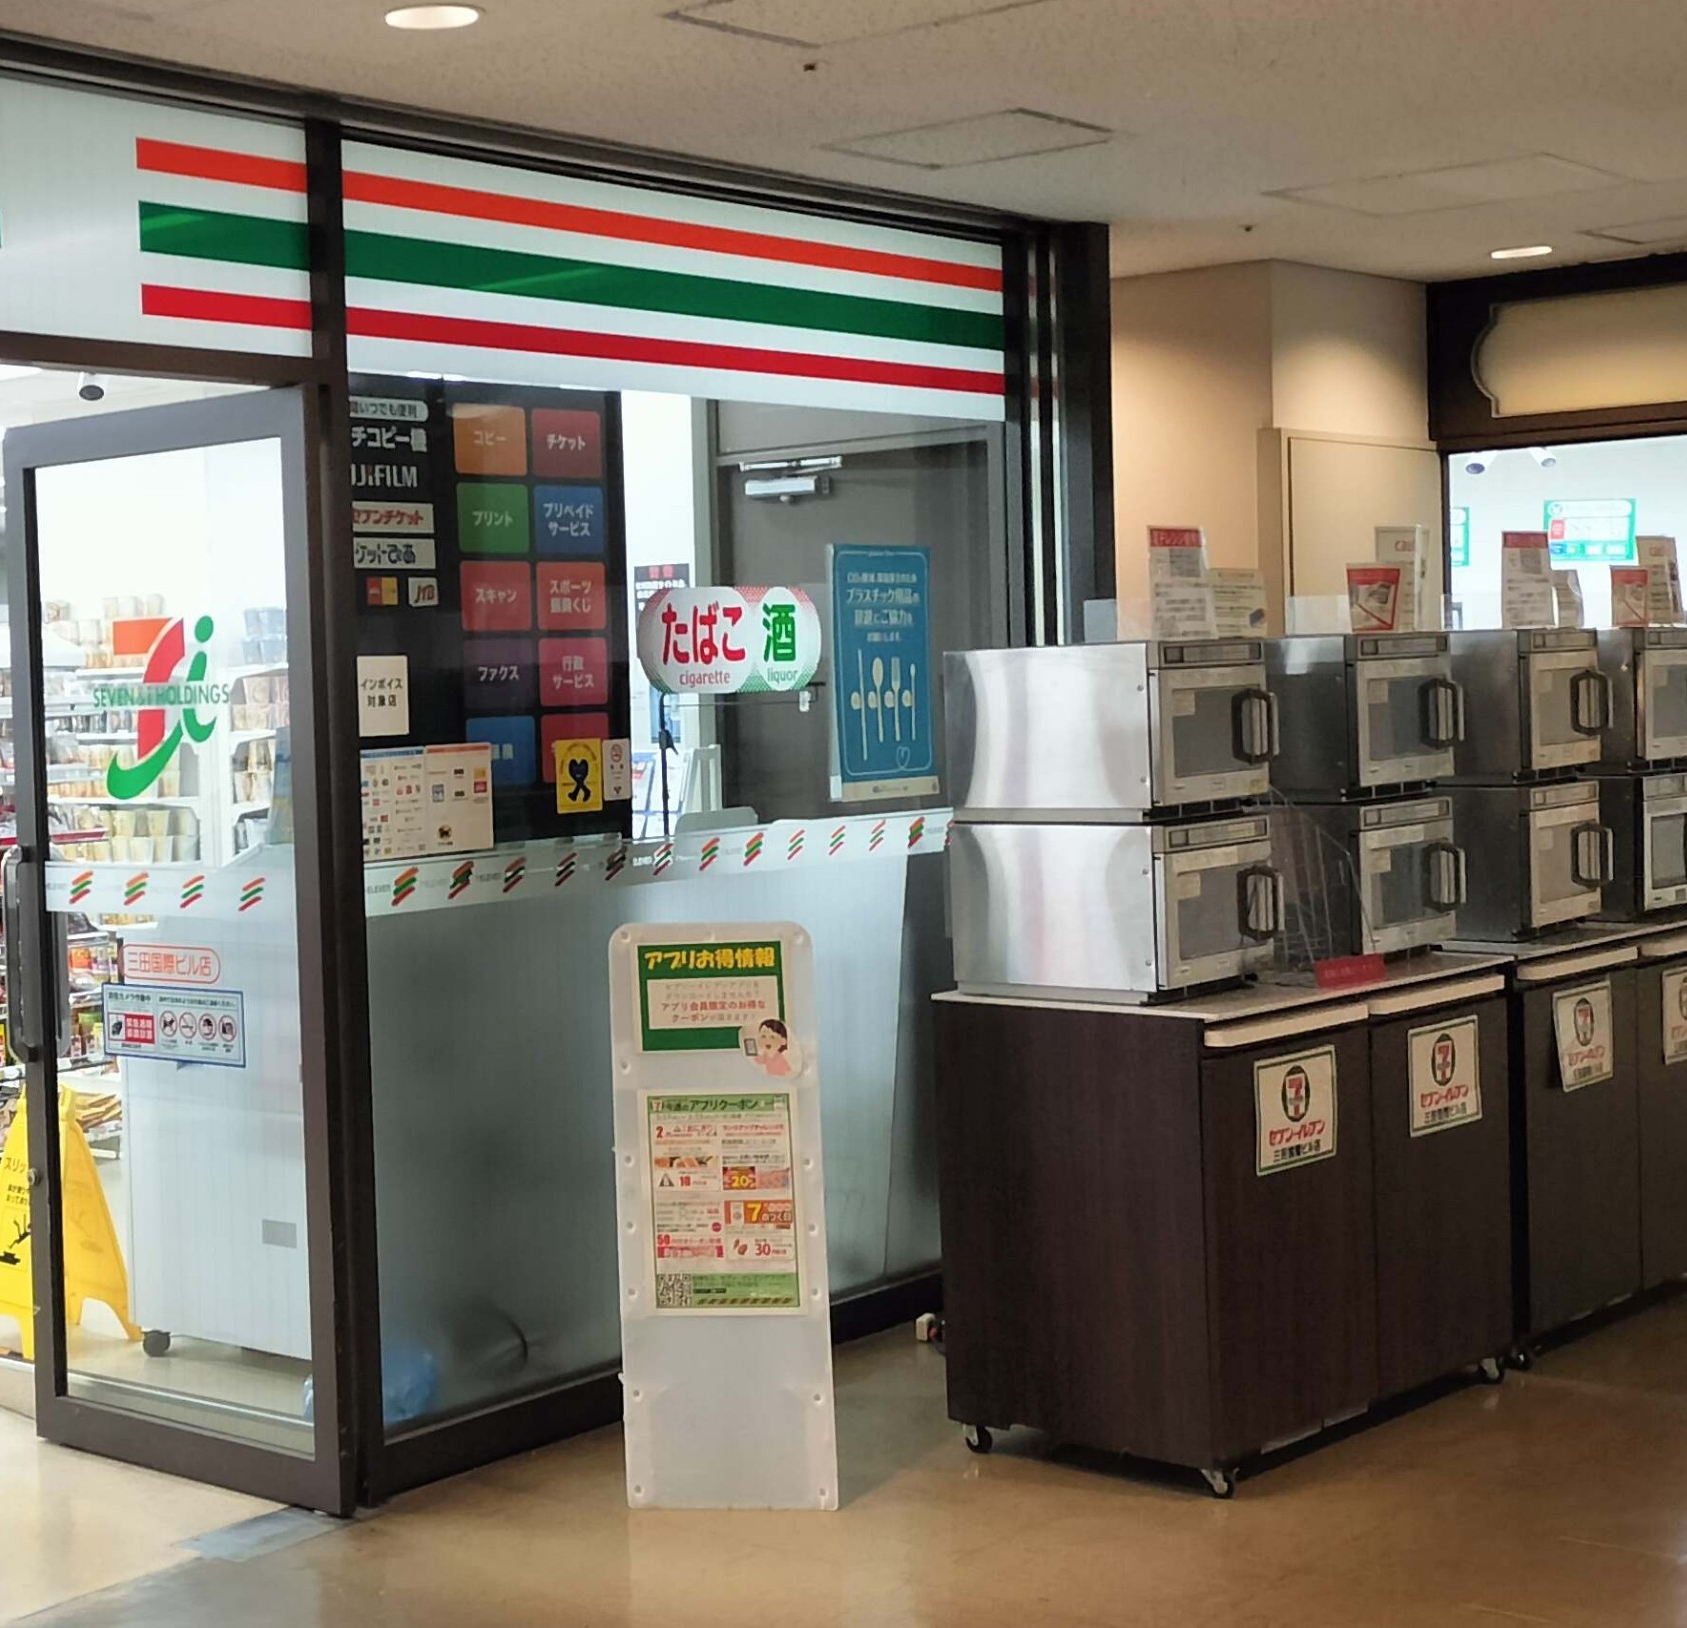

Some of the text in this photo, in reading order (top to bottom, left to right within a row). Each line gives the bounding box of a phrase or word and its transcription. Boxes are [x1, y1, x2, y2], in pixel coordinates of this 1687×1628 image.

[474, 431, 506, 446] コピー
[546, 434, 586, 450] チケット
[473, 511, 513, 527] プリント
[548, 522, 591, 537] サービス
[476, 589, 517, 602] スキャン
[662, 603, 745, 665] たばこ
[763, 603, 796, 662] 酒
[478, 666, 519, 682] ファクス
[553, 675, 594, 689] サービス
[679, 671, 730, 688] cigarette
[767, 667, 798, 684] liquor
[361, 678, 403, 690] インボイス
[367, 694, 397, 707] 対象店
[644, 946, 775, 970] アプリお得情報
[746, 1202, 763, 1222] 7
[755, 1244, 772, 1256] 30
